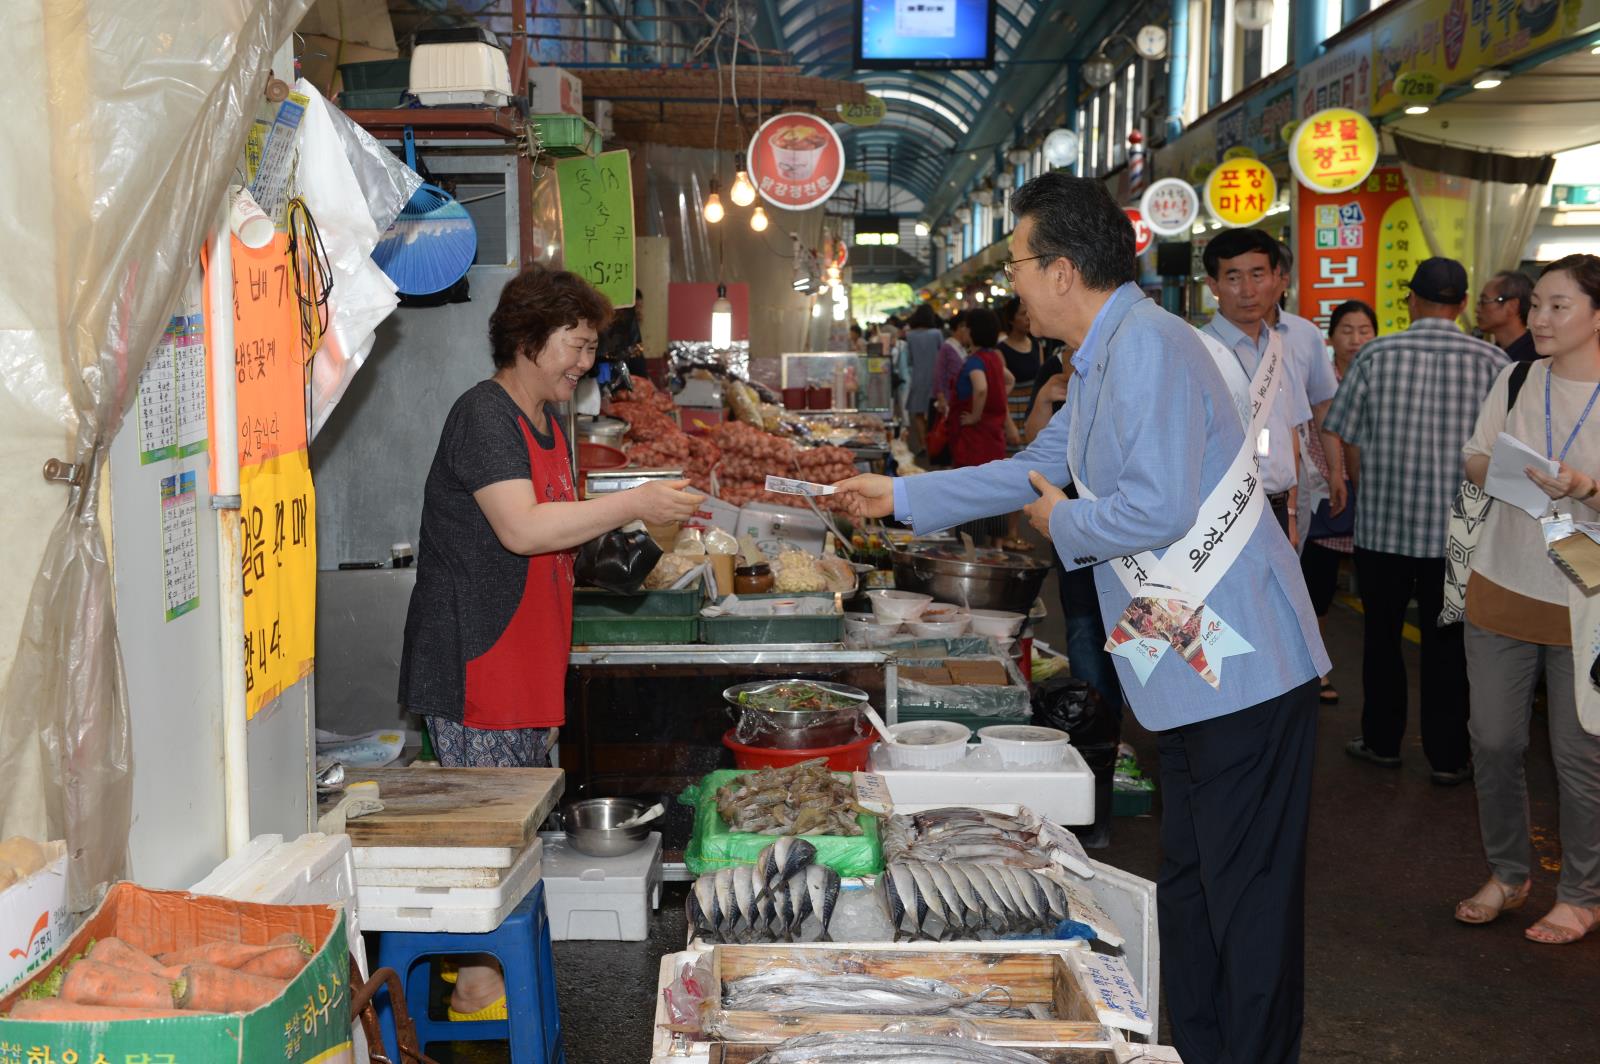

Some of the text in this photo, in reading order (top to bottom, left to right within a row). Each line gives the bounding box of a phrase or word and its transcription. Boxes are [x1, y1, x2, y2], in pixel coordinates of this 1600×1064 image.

[1313, 118, 1359, 141] 보물
[1313, 145, 1361, 170] 창고
[760, 175, 832, 198] 닭강정전문
[1219, 168, 1266, 189] 포장
[1219, 193, 1267, 214] 마차
[1318, 228, 1362, 248] 매장
[241, 411, 280, 461] 있습니다
[1189, 471, 1258, 574] 재래시장에
[303, 972, 345, 1038] 하우스
